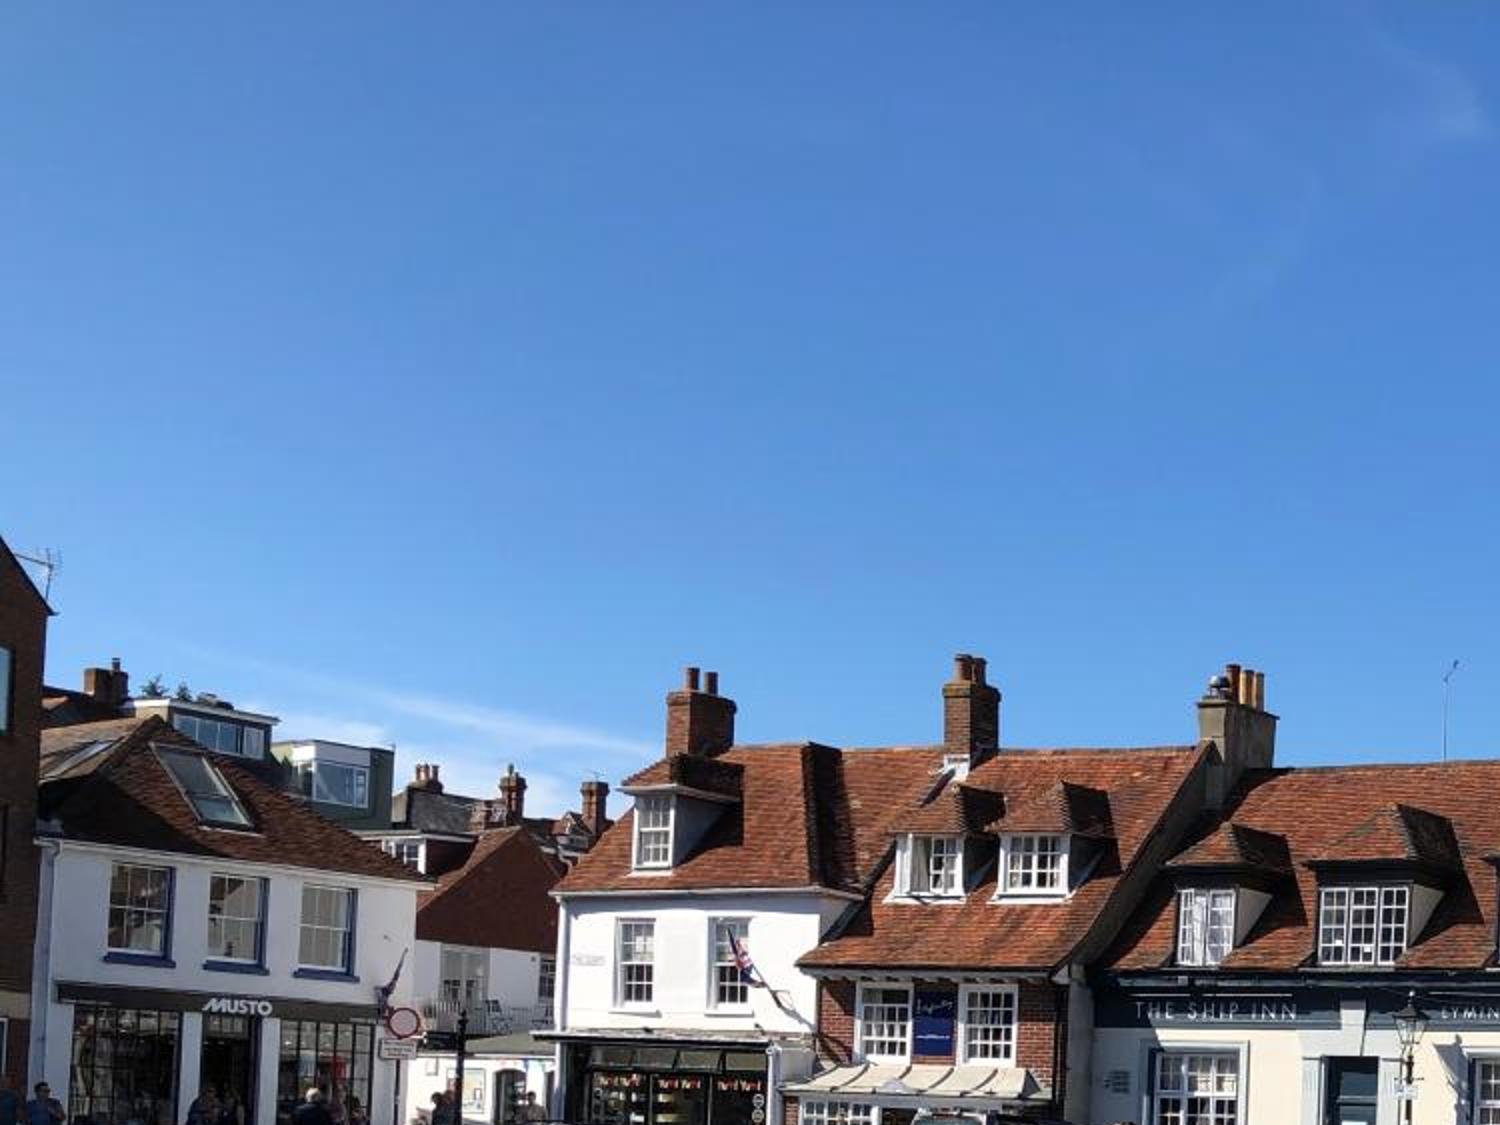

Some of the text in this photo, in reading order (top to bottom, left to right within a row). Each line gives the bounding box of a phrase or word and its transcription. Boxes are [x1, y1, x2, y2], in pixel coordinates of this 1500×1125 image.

[202, 997, 272, 1016] MUSTO
[1135, 1001, 1297, 1019] THE SHIP INN
